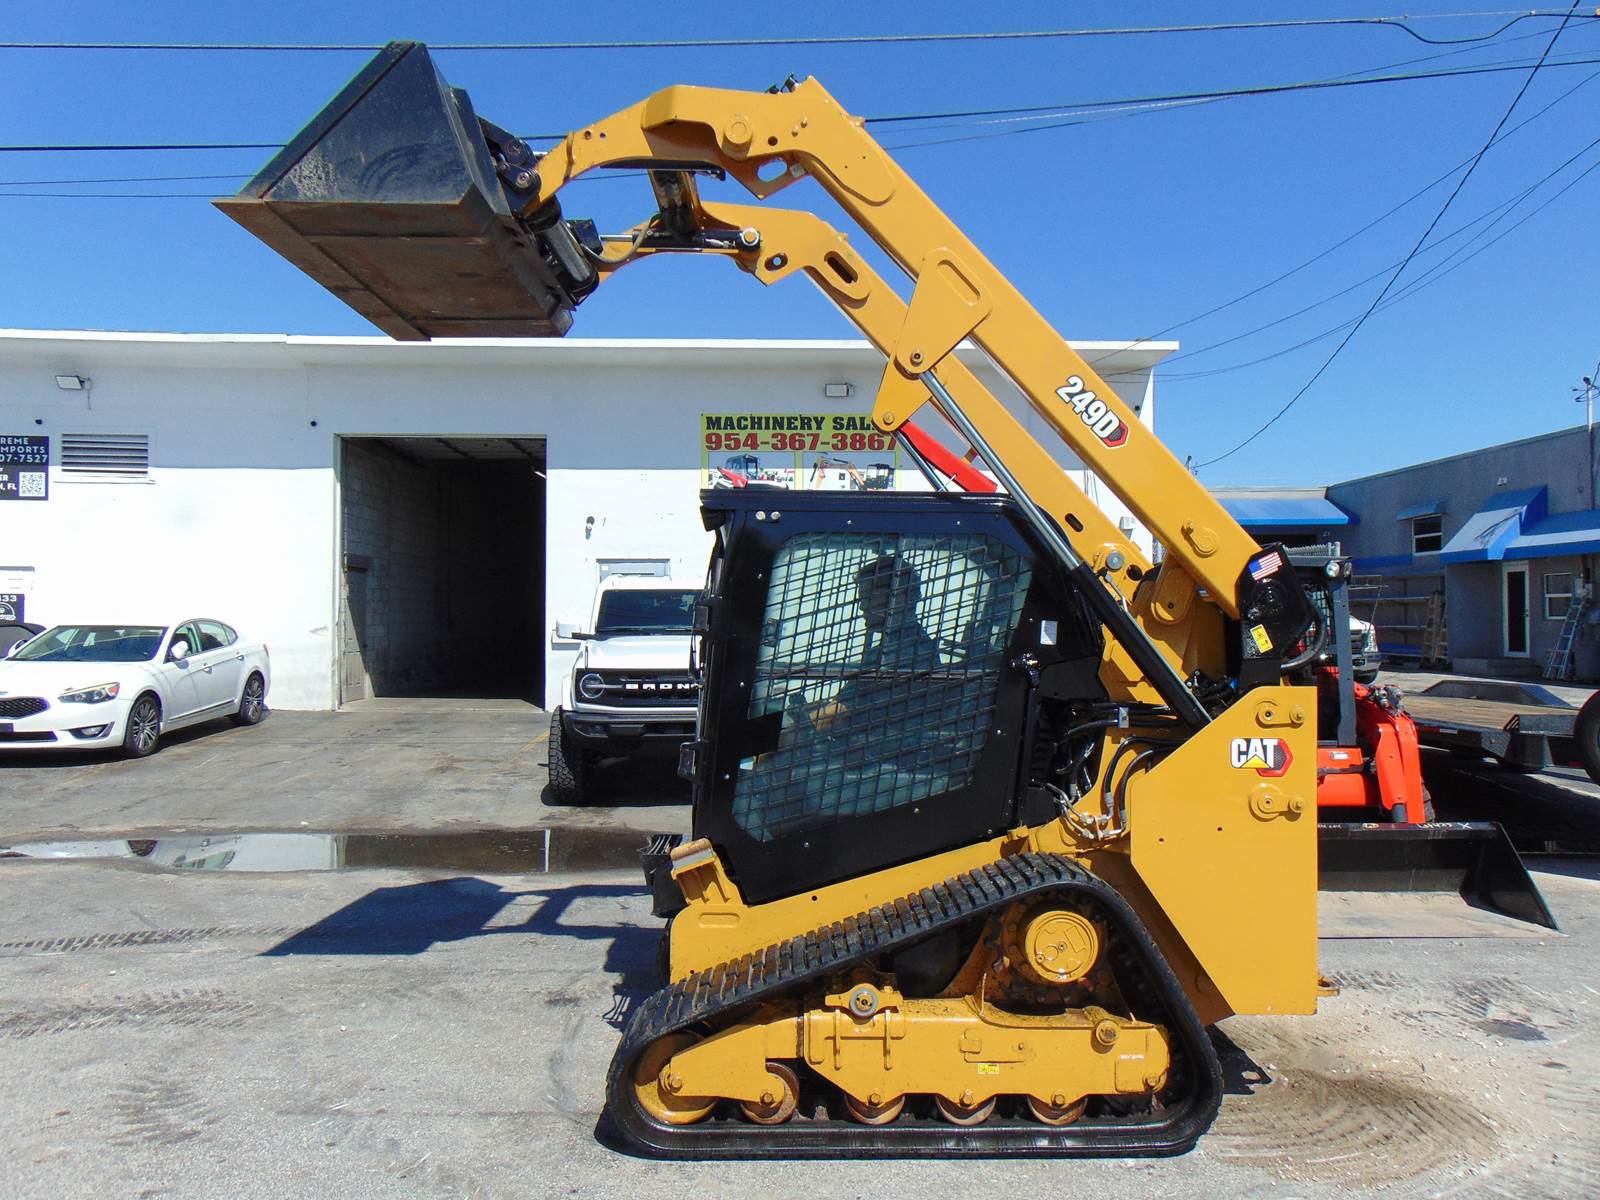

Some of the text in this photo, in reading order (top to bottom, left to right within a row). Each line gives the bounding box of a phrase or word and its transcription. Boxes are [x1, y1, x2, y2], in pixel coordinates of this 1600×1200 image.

[1055, 375, 1121, 440] 249D
[705, 415, 875, 431] MACHINERY SAL
[705, 432, 897, 451] 954-367-3867
[1231, 738, 1279, 769] CAT
